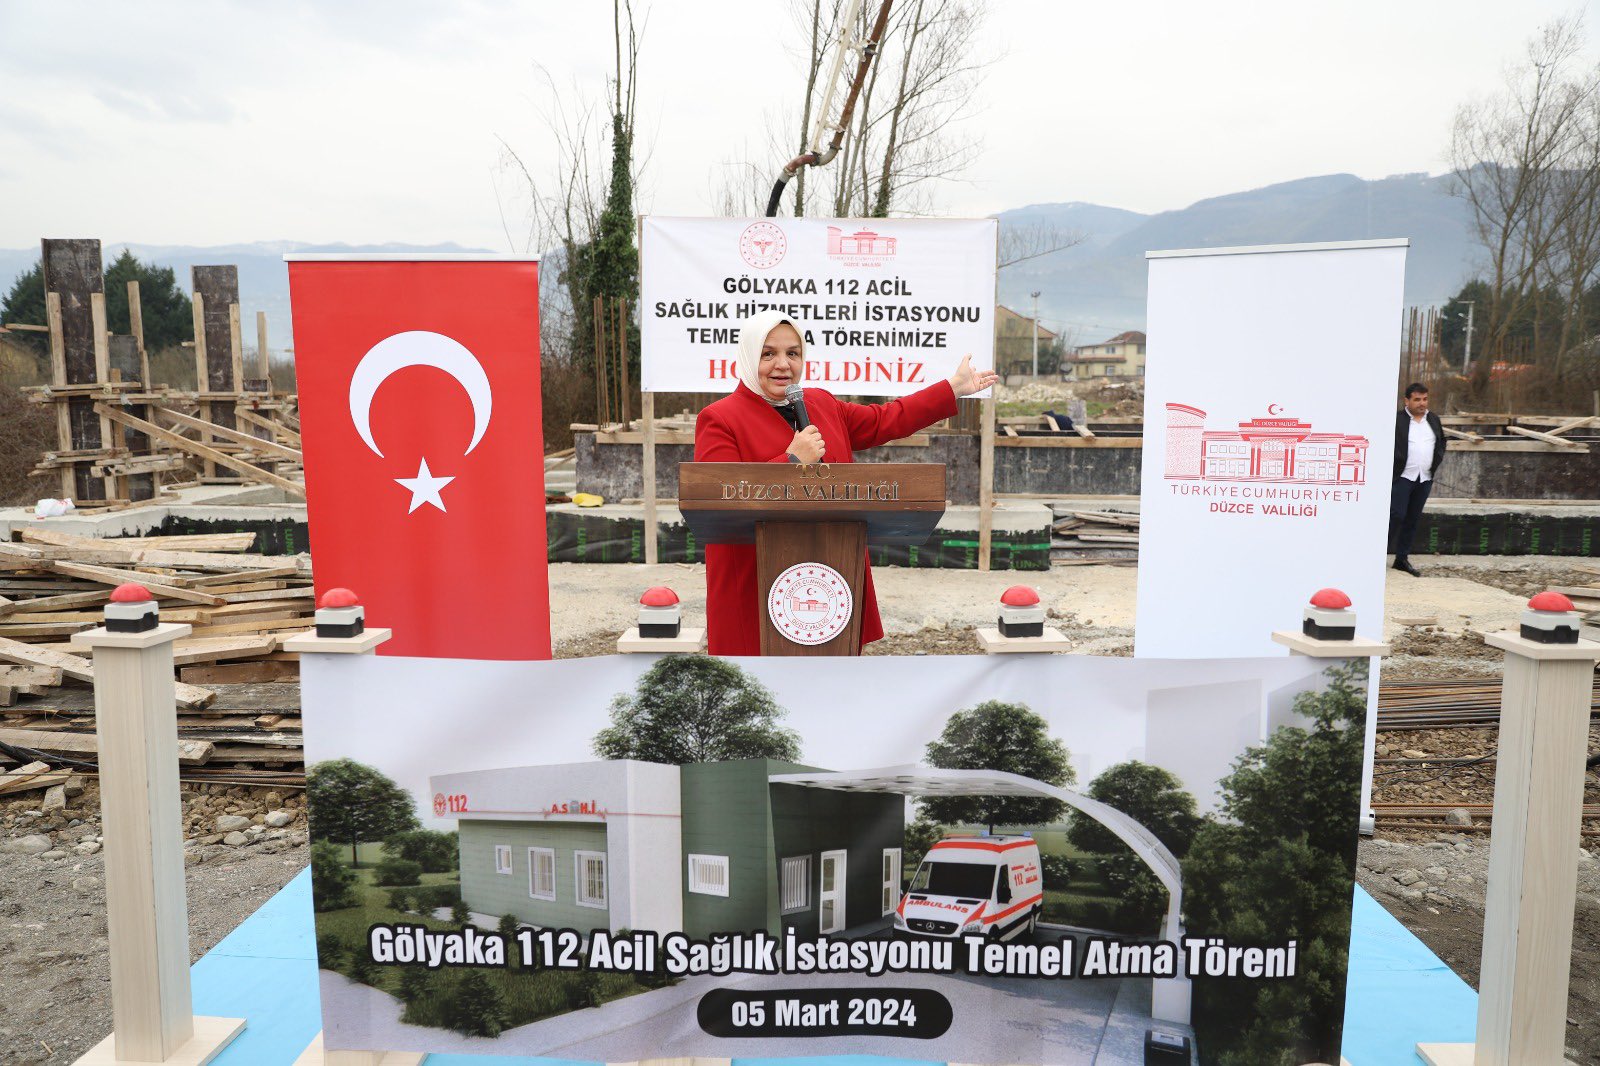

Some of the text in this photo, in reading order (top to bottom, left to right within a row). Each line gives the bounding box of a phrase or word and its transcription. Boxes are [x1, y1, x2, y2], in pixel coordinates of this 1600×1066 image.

[723, 274, 912, 296] GÖLYAKA 112 ACİL
[655, 298, 729, 319] SAĞLIK
[865, 301, 981, 323] İSTASYONU
[687, 328, 741, 344] TEME
[823, 326, 947, 348] TÖRENİMİZE
[806, 356, 926, 383] ELDİNİZ
[796, 463, 836, 479] T.C.
[721, 480, 900, 501] DÜZCE VALİLİĞİ
[1171, 484, 1360, 502] TÜRKİYE CUMHURİYETİ
[1210, 501, 1318, 517] DÜZCE VALİLİĞİ
[631, 529, 641, 559] LUNA
[448, 794, 468, 812] 112
[907, 900, 969, 913] AMBULANS
[371, 926, 1297, 978] Gölyaka 112 Acil Sağlık İstasyonu Temel Atma Töreni
[731, 998, 917, 1028] 05 Mart 2024
